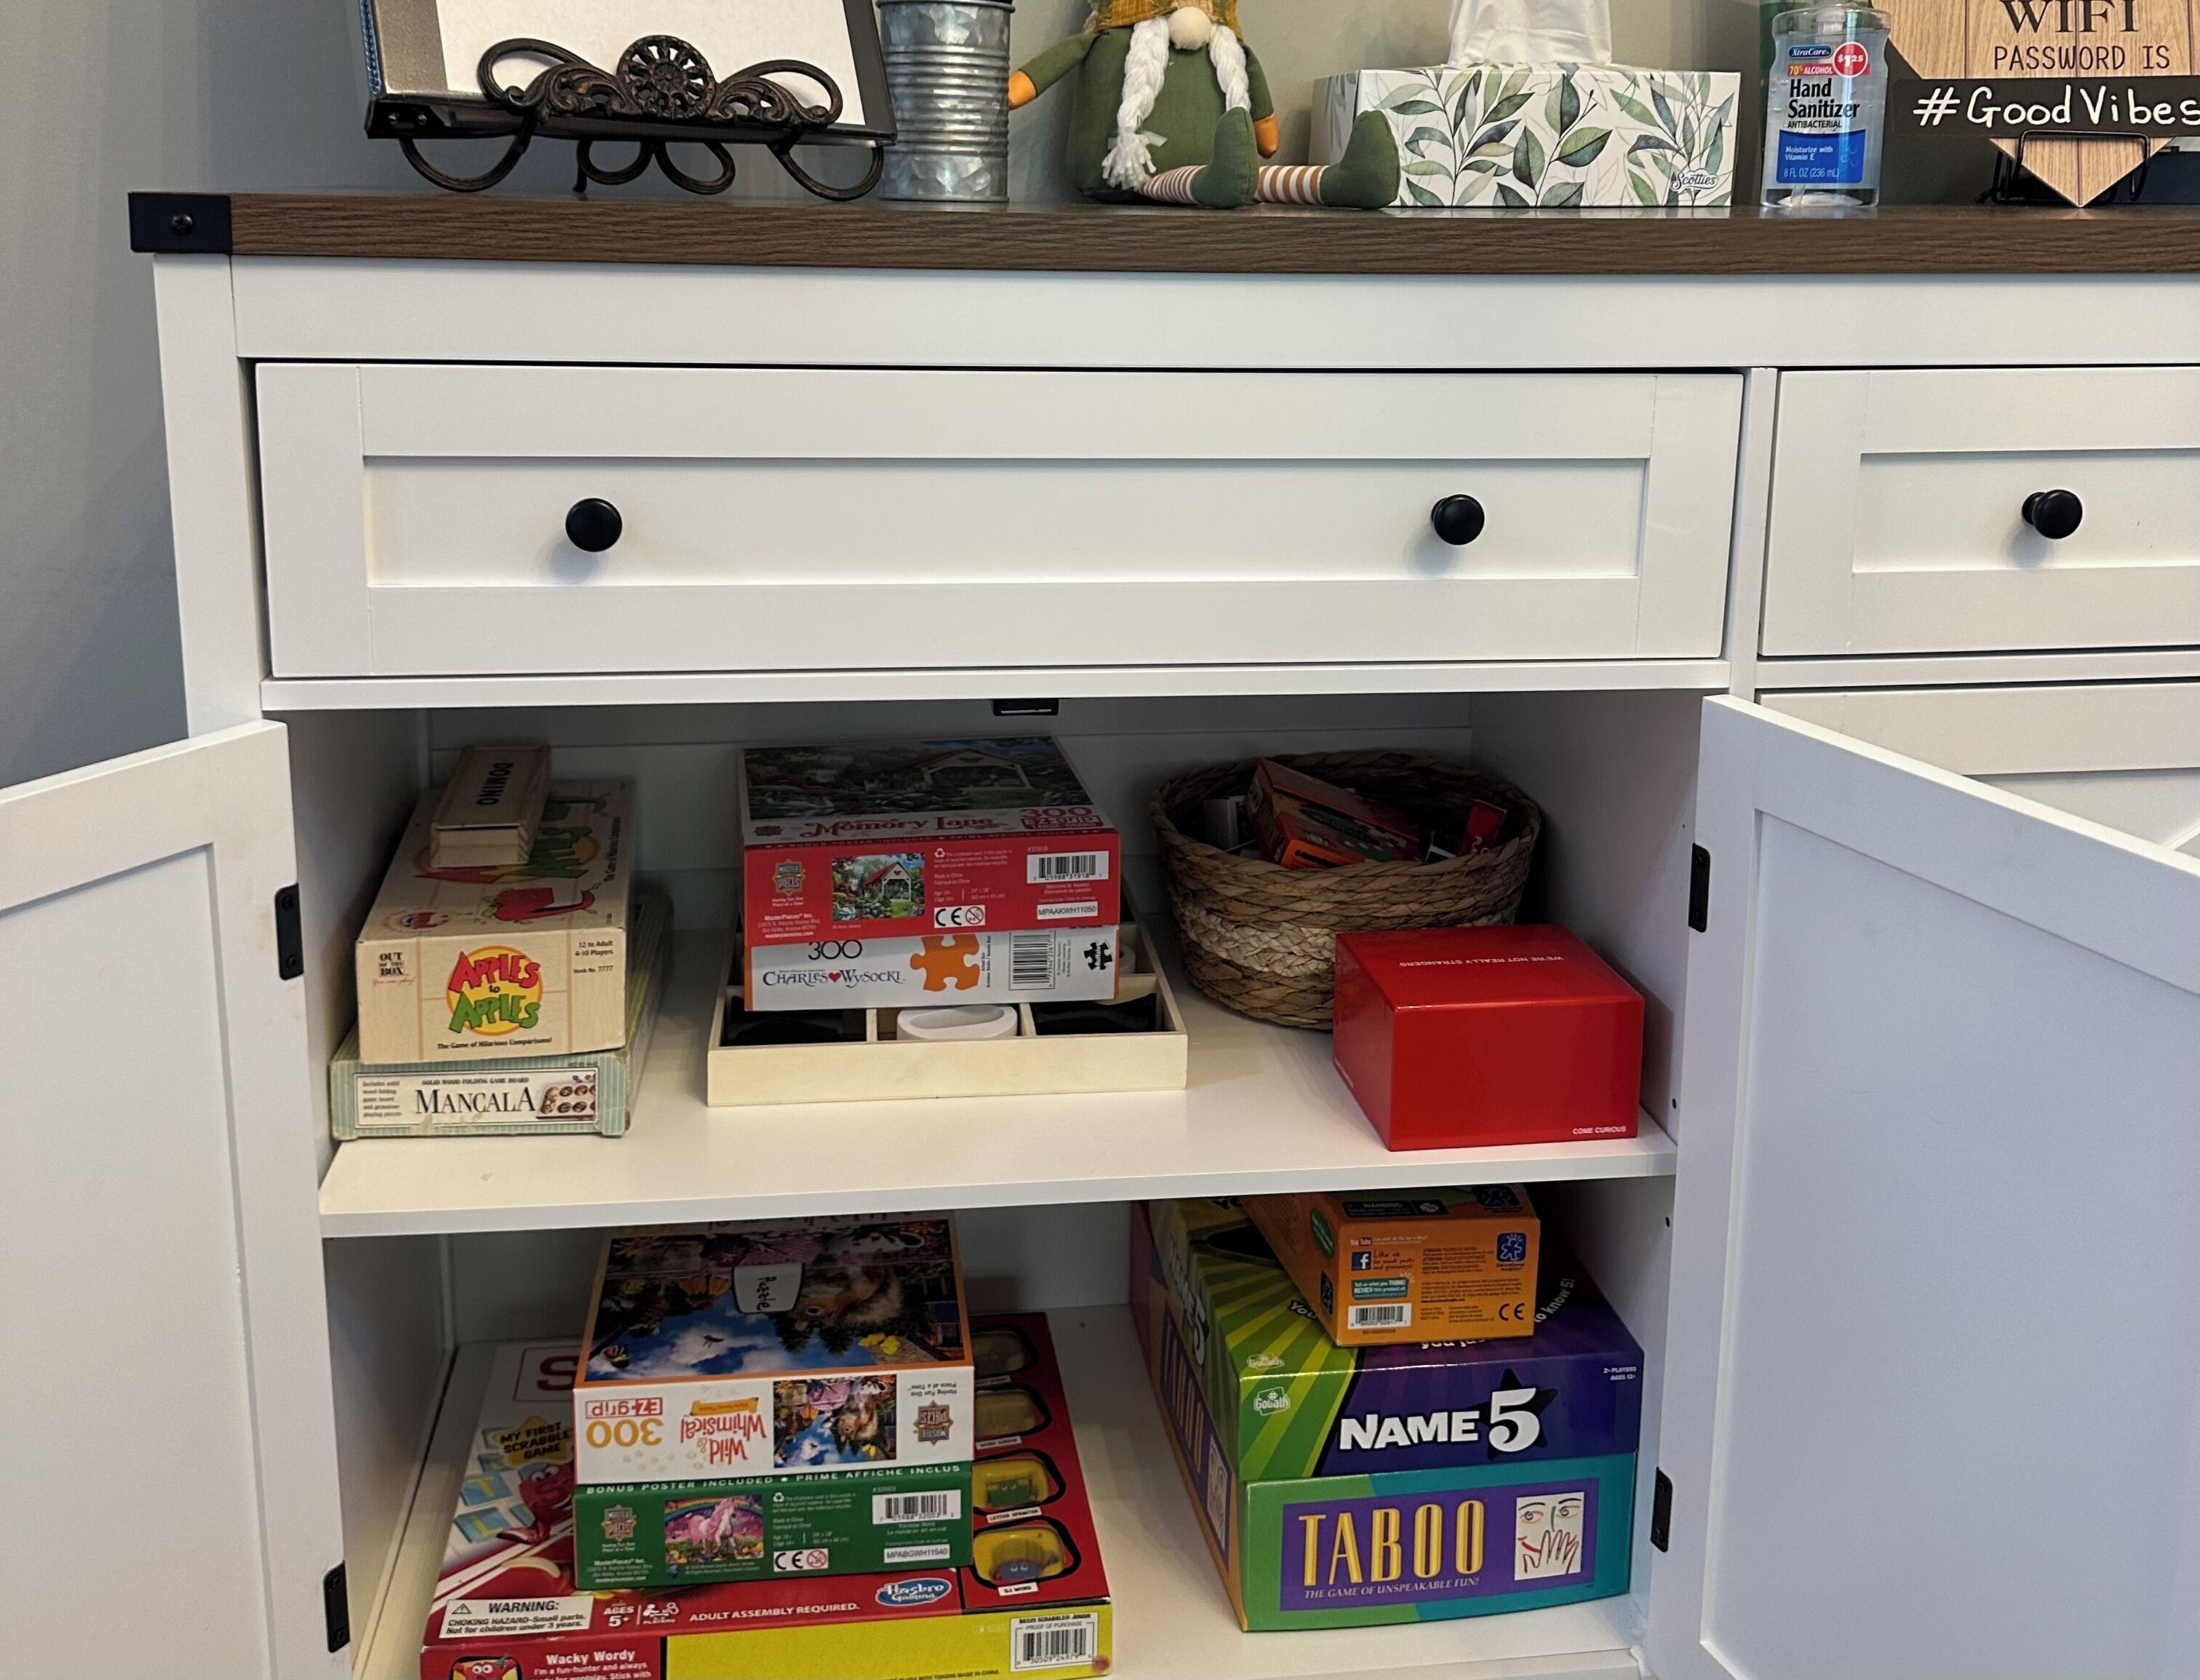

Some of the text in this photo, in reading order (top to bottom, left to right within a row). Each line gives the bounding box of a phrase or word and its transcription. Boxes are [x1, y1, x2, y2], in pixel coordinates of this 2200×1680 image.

[2002, 0, 2139, 33] WIFI
[1792, 48, 1828, 56] XtraCare
[1995, 44, 2170, 71] PASSWORD IS
[1804, 66, 1833, 75] ALCOHOL
[1790, 78, 1832, 97] Hand
[1788, 99, 1860, 118] Sanitizer
[1788, 120, 1841, 129] ANTIBACTERIAL
[1671, 172, 1717, 189] Scotties
[1784, 169, 1788, 178] 8
[1790, 168, 1797, 178] FL
[1799, 168, 1808, 178] OZ
[1810, 167, 1825, 178] (236
[800, 817, 930, 837] Memory
[379, 952, 403, 960] OUT
[808, 939, 863, 960] 300
[380, 967, 404, 976] BOX
[1400, 959, 1464, 967] STRANGERS
[448, 951, 541, 993] APPLES
[489, 984, 501, 993] to
[448, 992, 541, 1033] APPLES
[451, 1041, 469, 1049] Game
[479, 1039, 507, 1048] Hilarious
[415, 1086, 536, 1115] MANCALA
[1572, 1126, 1627, 1135] COME CURIOUS
[1547, 1277, 1575, 1315] know 5!
[1256, 1396, 1290, 1410] Goliath
[680, 1413, 768, 1443] Whimsical
[1339, 1388, 1541, 1453] NAME 5
[501, 1421, 562, 1444] MY FIRST
[503, 1428, 572, 1453] SCRABBLE
[586, 1417, 663, 1448] 300
[524, 1442, 561, 1460] GAME
[697, 1437, 749, 1465] Wild &
[586, 1465, 961, 1494] BONUS POSTER INCLUDED PRIME AFFICHE INCLUS
[1298, 1500, 1485, 1586] TABOO
[885, 1582, 945, 1596] Hasbro
[1304, 1577, 1480, 1599] THE GAME OF UNSPEAKABLE FUN!
[891, 1592, 937, 1603] Gaming
[489, 1600, 559, 1614] WARNING:
[603, 1605, 635, 1615] AGES
[690, 1602, 860, 1623] ADULT ASSEMBLY REQUIRED.
[446, 1626, 462, 1635] Not
[463, 1626, 478, 1634] for
[479, 1623, 517, 1633] children
[519, 1623, 546, 1631] under
[555, 1620, 583, 1630] years.
[448, 1617, 489, 1627] CHOKING
[560, 1613, 586, 1622] parts.
[546, 1649, 636, 1665] Wacky Wordy
[534, 1668, 549, 1676] I'm
[556, 1665, 601, 1675] fun-hunter
[602, 1663, 618, 1671] and
[619, 1662, 647, 1671] always
[633, 1671, 652, 1679] with
